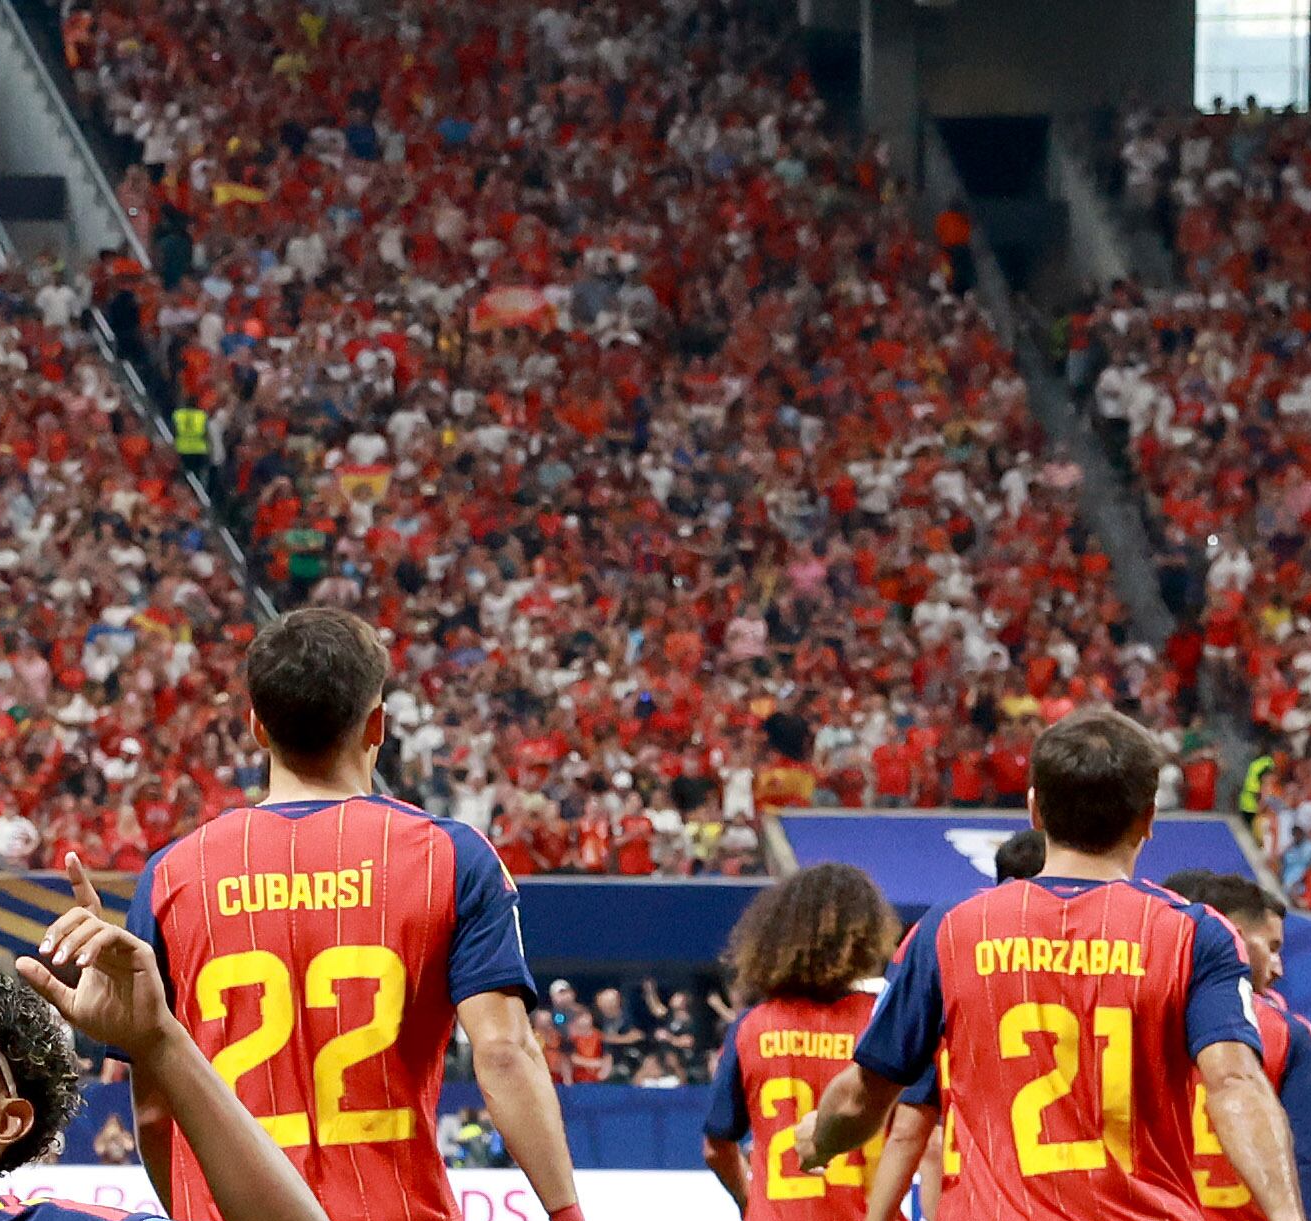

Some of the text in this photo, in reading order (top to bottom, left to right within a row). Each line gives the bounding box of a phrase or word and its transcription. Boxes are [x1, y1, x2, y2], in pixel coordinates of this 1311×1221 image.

[217, 859, 374, 916] CUBARSÍ
[975, 936, 1146, 977] OYARZABAL
[196, 945, 416, 1147] 22
[999, 1001, 1133, 1178] 21
